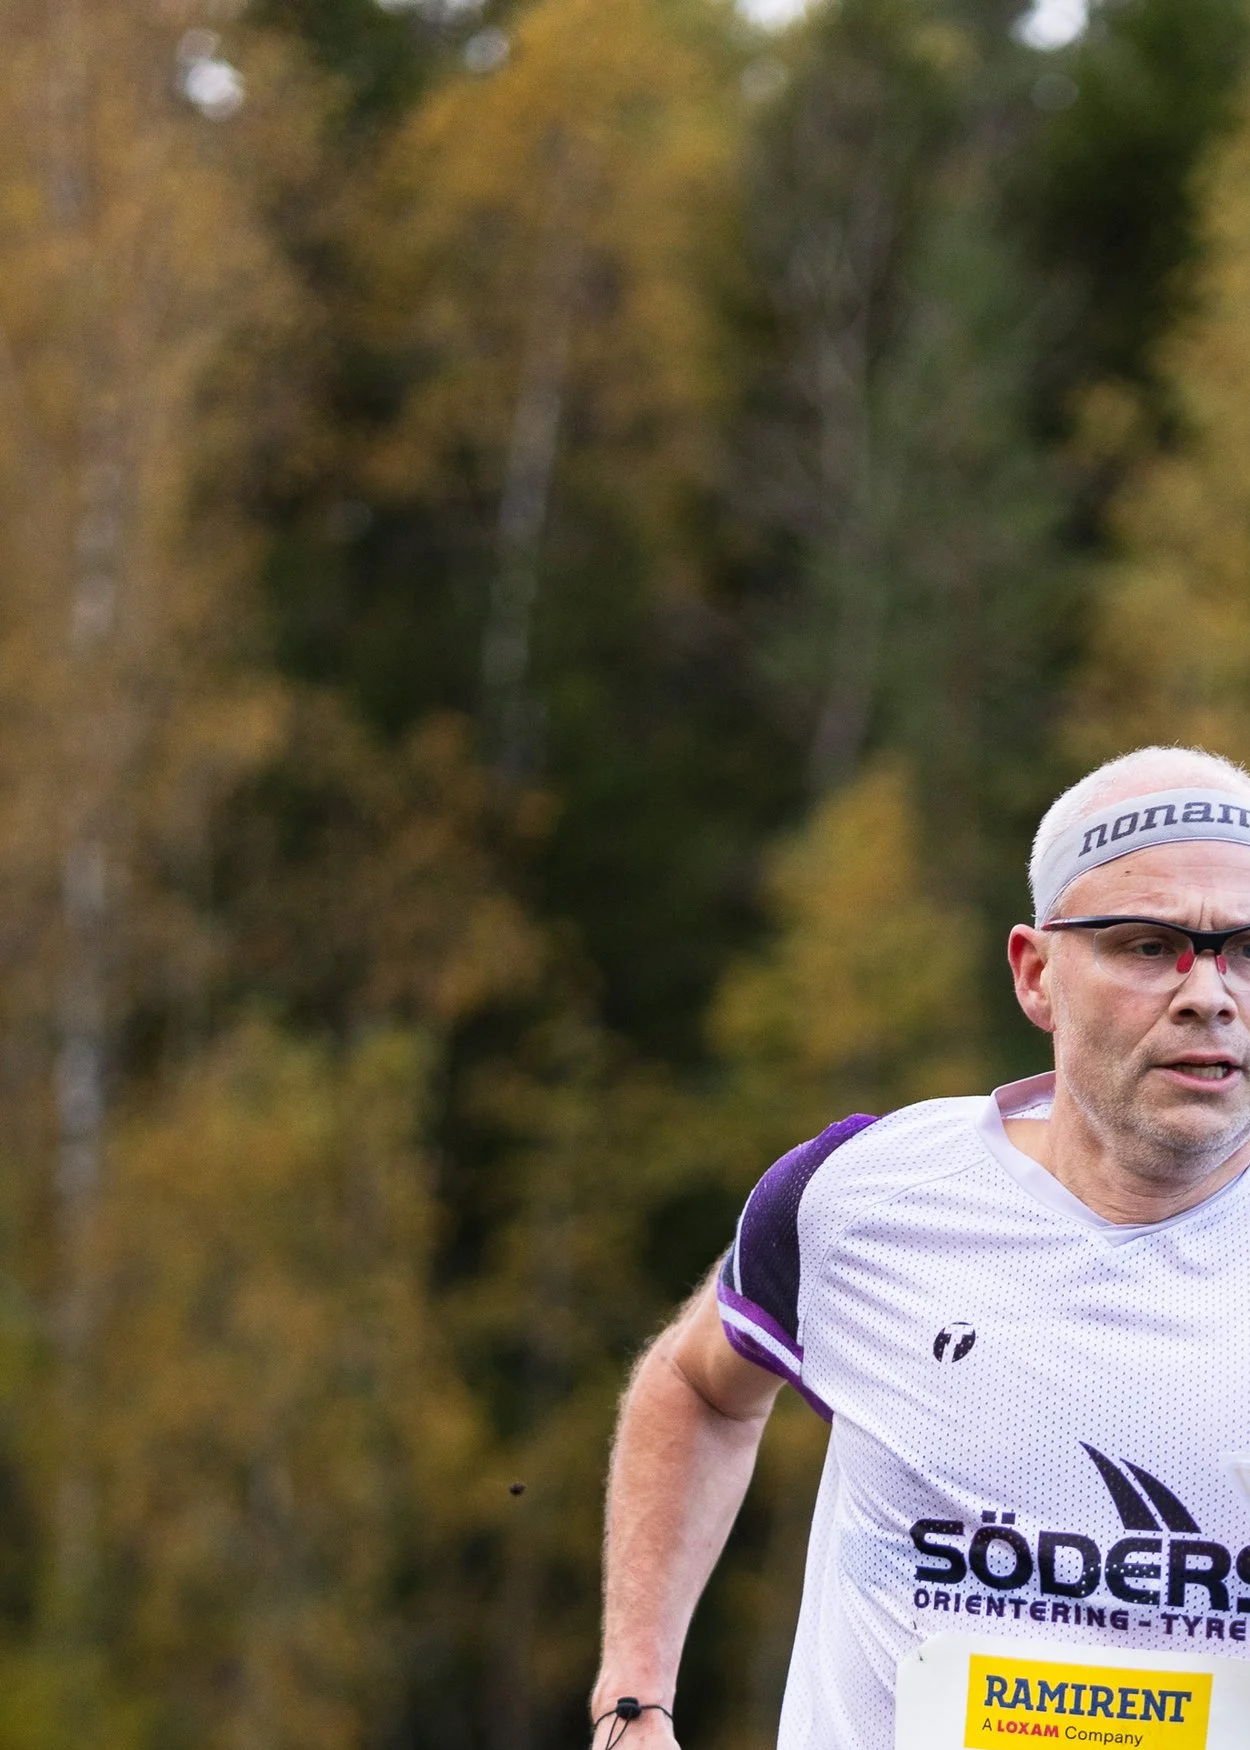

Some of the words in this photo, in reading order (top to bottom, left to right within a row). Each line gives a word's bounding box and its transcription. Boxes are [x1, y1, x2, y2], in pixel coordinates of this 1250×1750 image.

[984, 1673, 1192, 1723] RAMIRENT
[982, 1718, 993, 1732] A
[997, 1718, 1060, 1739] LOXAM
[1065, 1725, 1143, 1748] Company
